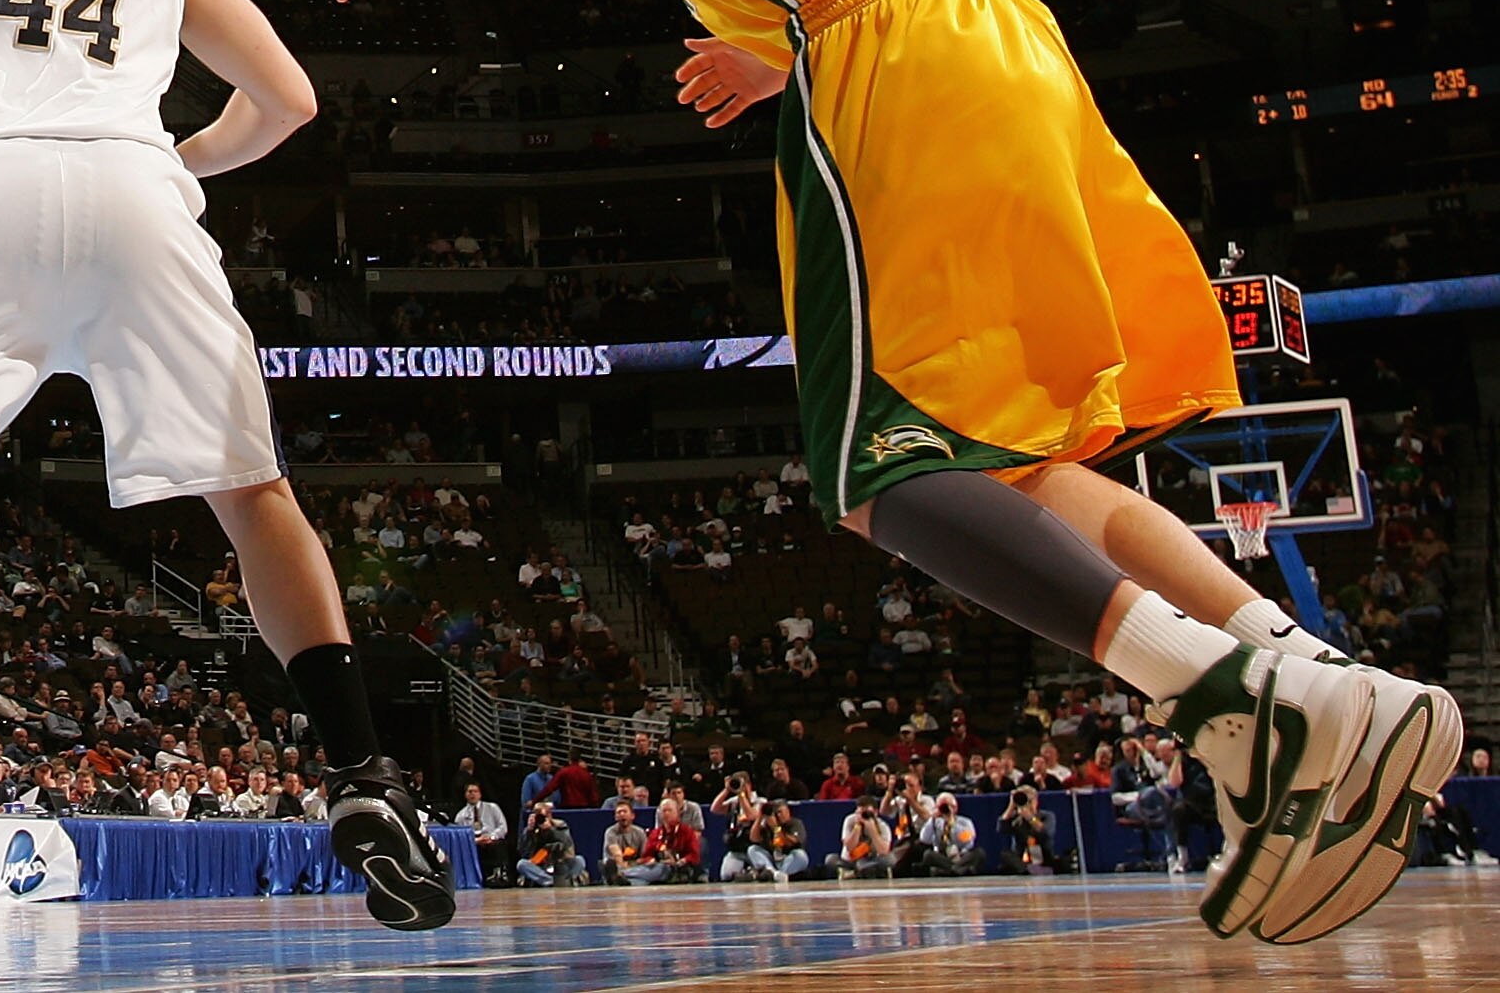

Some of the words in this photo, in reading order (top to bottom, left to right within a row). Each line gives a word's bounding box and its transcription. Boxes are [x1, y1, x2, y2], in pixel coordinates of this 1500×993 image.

[1434, 68, 1467, 91] 2:35
[1291, 104, 1308, 120] 10
[1360, 91, 1394, 110] 64
[527, 134, 550, 146] 357
[307, 347, 368, 378] AND
[375, 347, 486, 378] SECOND
[493, 345, 612, 377] ROUNDS
